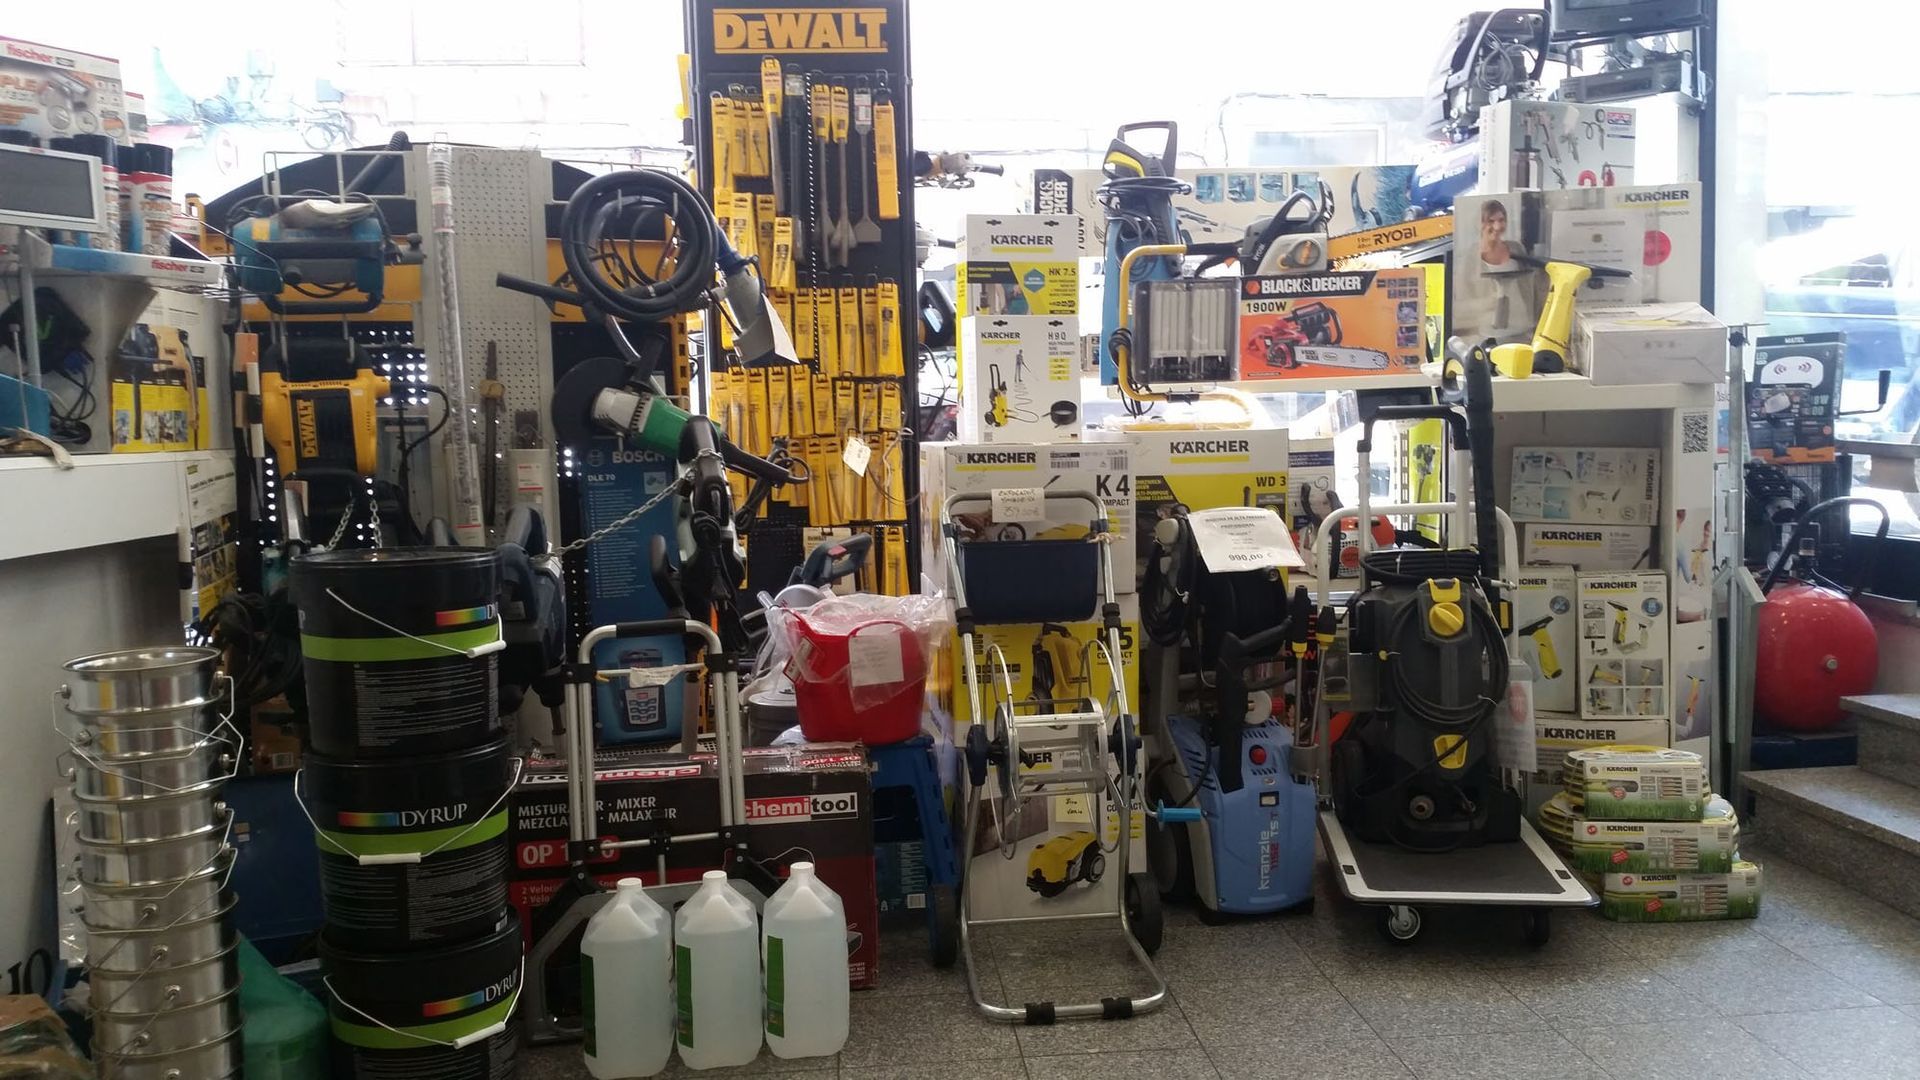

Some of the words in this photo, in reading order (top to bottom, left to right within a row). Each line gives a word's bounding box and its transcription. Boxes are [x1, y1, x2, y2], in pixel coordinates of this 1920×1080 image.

[713, 12, 888, 49] DEWALT
[7, 43, 53, 63] fischer
[1039, 180, 1054, 214] ACK&
[1054, 181, 1068, 214] CKER
[1624, 190, 1690, 203] KÄRCHER
[990, 235, 1054, 245] KÄRCHER
[1373, 225, 1418, 246] RYOBI
[151, 260, 188, 271] fischer
[1247, 301, 1287, 313] 1900W
[1170, 439, 1249, 454] KÄRCHER
[612, 450, 665, 464] BOSCH
[967, 452, 1036, 464] KÄRCHER
[604, 473, 616, 481] 70
[1256, 476, 1276, 487] WD
[1280, 475, 1286, 487] 3
[1096, 474, 1111, 497] K
[1116, 474, 1130, 496] 4
[1102, 498, 1130, 506] OMPACT
[1541, 531, 1602, 541] KÄRCHER
[1590, 581, 1637, 589] KÄRCHER
[1543, 728, 1616, 740] KÄRCHER
[616, 796, 657, 810] MIXER
[402, 803, 468, 827] DYRUP
[522, 843, 553, 864] OP
